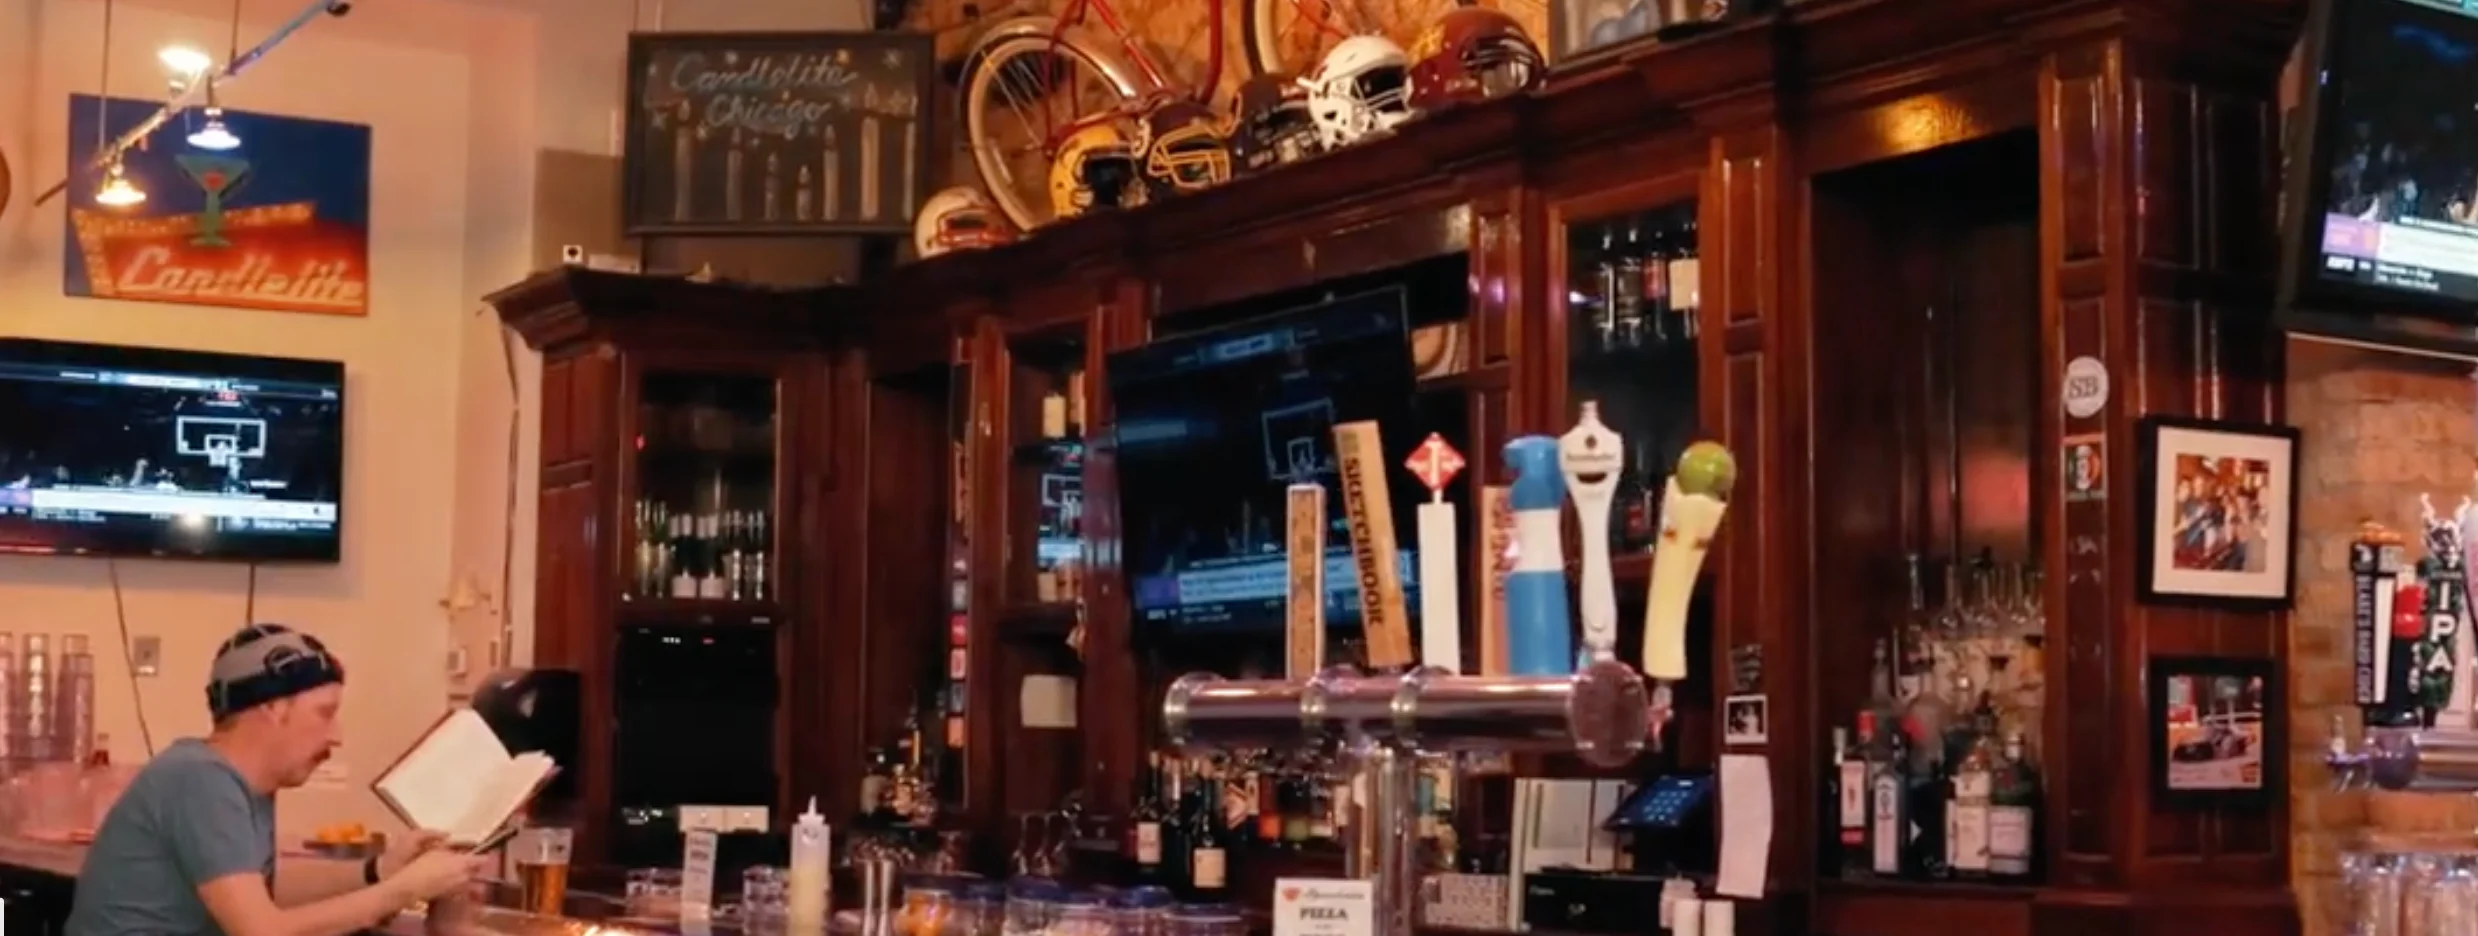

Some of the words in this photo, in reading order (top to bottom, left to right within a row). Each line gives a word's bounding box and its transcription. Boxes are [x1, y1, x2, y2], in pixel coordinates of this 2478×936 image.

[706, 93, 831, 140] Chicago
[114, 246, 366, 307] Candlelite
[1345, 456, 1385, 626] SKETCHBOOK
[1300, 907, 1348, 920] PIZZA
